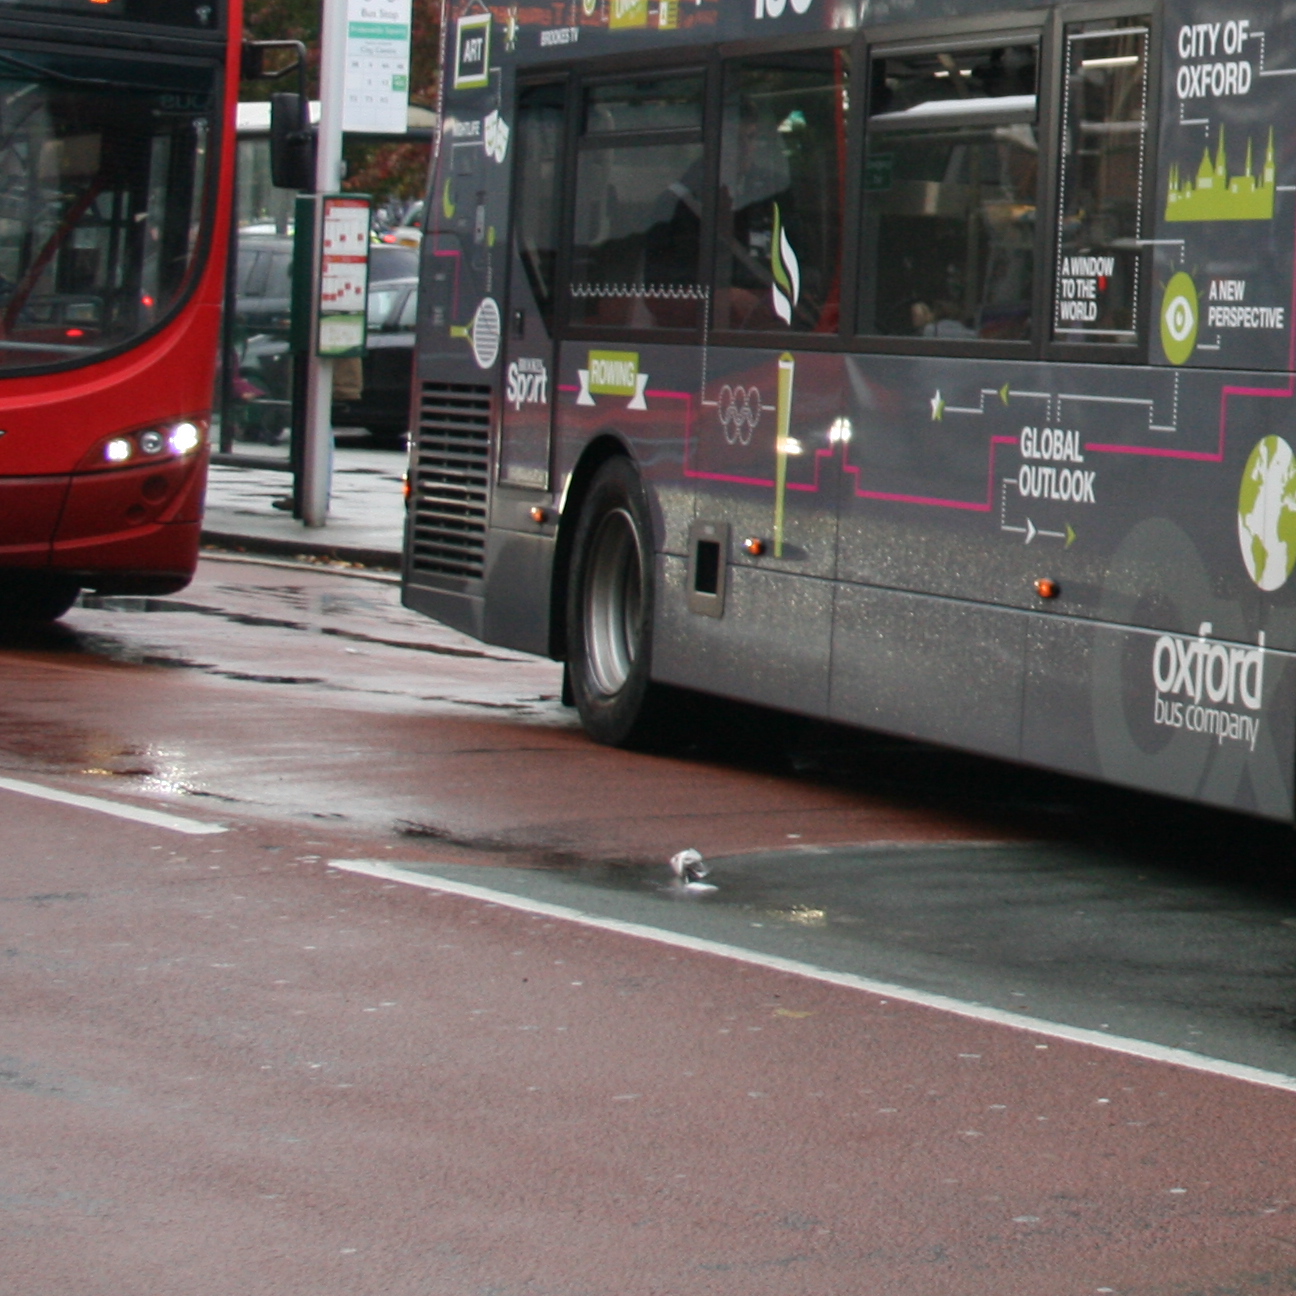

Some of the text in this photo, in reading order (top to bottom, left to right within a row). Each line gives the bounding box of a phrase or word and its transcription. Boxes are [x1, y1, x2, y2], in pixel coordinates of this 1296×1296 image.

[463, 37, 483, 62] ART
[540, 27, 580, 47] BROOKES TV
[1178, 20, 1250, 59] CITY OF
[1176, 61, 1252, 100] OXFORD
[1062, 256, 1115, 277] A WINDOW
[1061, 279, 1097, 298] TO THE
[1209, 280, 1246, 301] A NEW
[1060, 301, 1098, 322] WORLD
[1207, 306, 1285, 329] PERSPECTIVE
[507, 362, 548, 411] Sport
[591, 359, 636, 387] ROWING
[1020, 426, 1085, 463] GLOBAL
[1018, 464, 1096, 504] OUTLOOK
[1152, 622, 1266, 710] oxford
[1153, 689, 1260, 752] bus company
